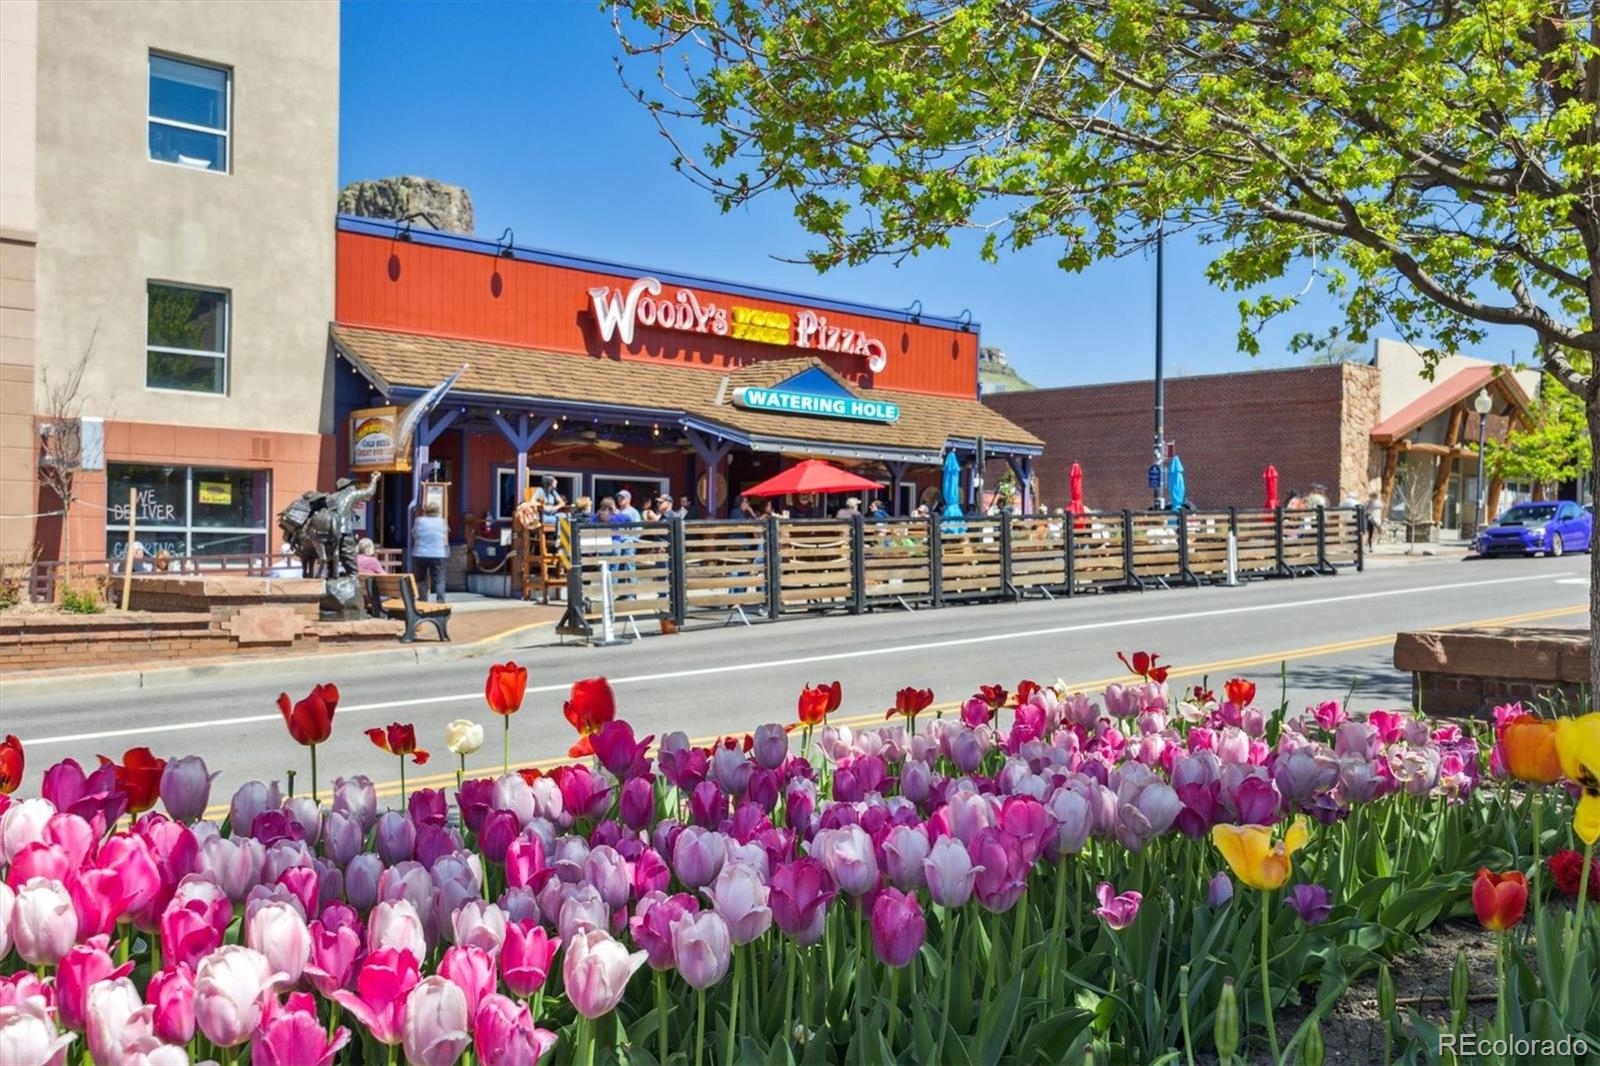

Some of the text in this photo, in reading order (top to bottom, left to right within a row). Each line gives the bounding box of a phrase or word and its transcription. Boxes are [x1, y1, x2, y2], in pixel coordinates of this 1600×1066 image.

[748, 390, 896, 419] WATERING HOLE
[135, 489, 157, 504] WE
